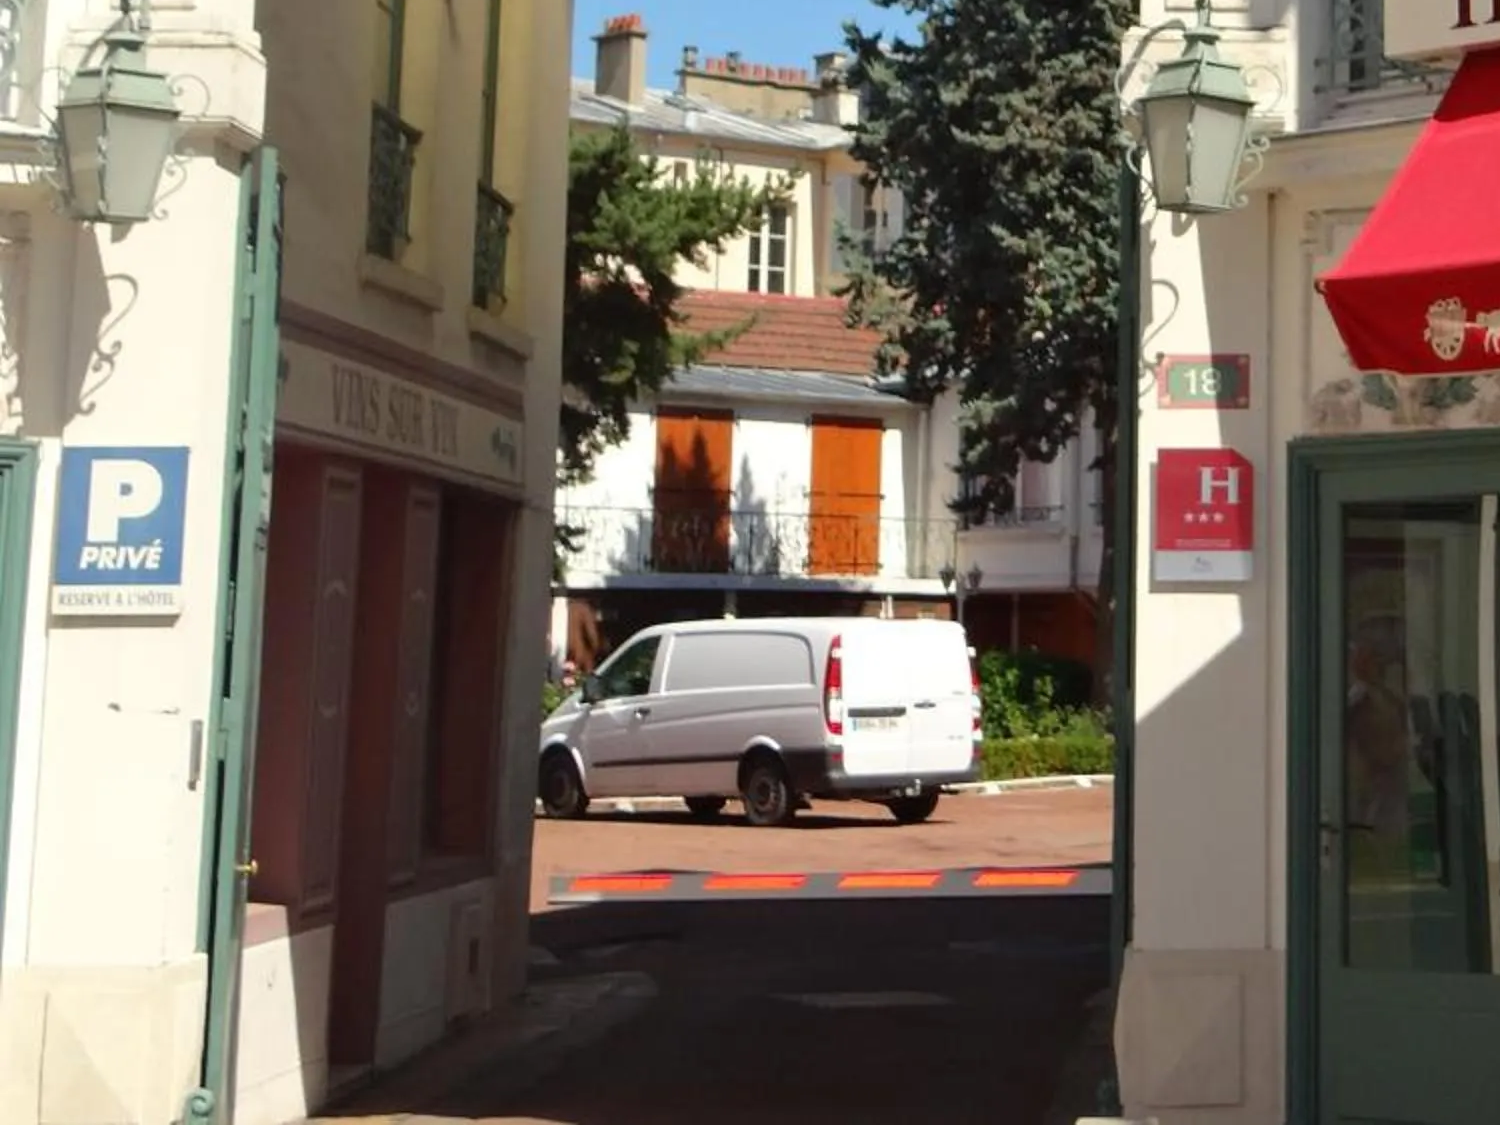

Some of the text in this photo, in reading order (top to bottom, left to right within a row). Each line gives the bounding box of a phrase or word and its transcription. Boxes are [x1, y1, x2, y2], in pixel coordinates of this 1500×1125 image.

[332, 363, 381, 435] VINS
[1183, 367, 1222, 396] 18
[87, 459, 163, 543] P
[1199, 466, 1240, 505] H
[79, 538, 164, 570] PRIVÉ
